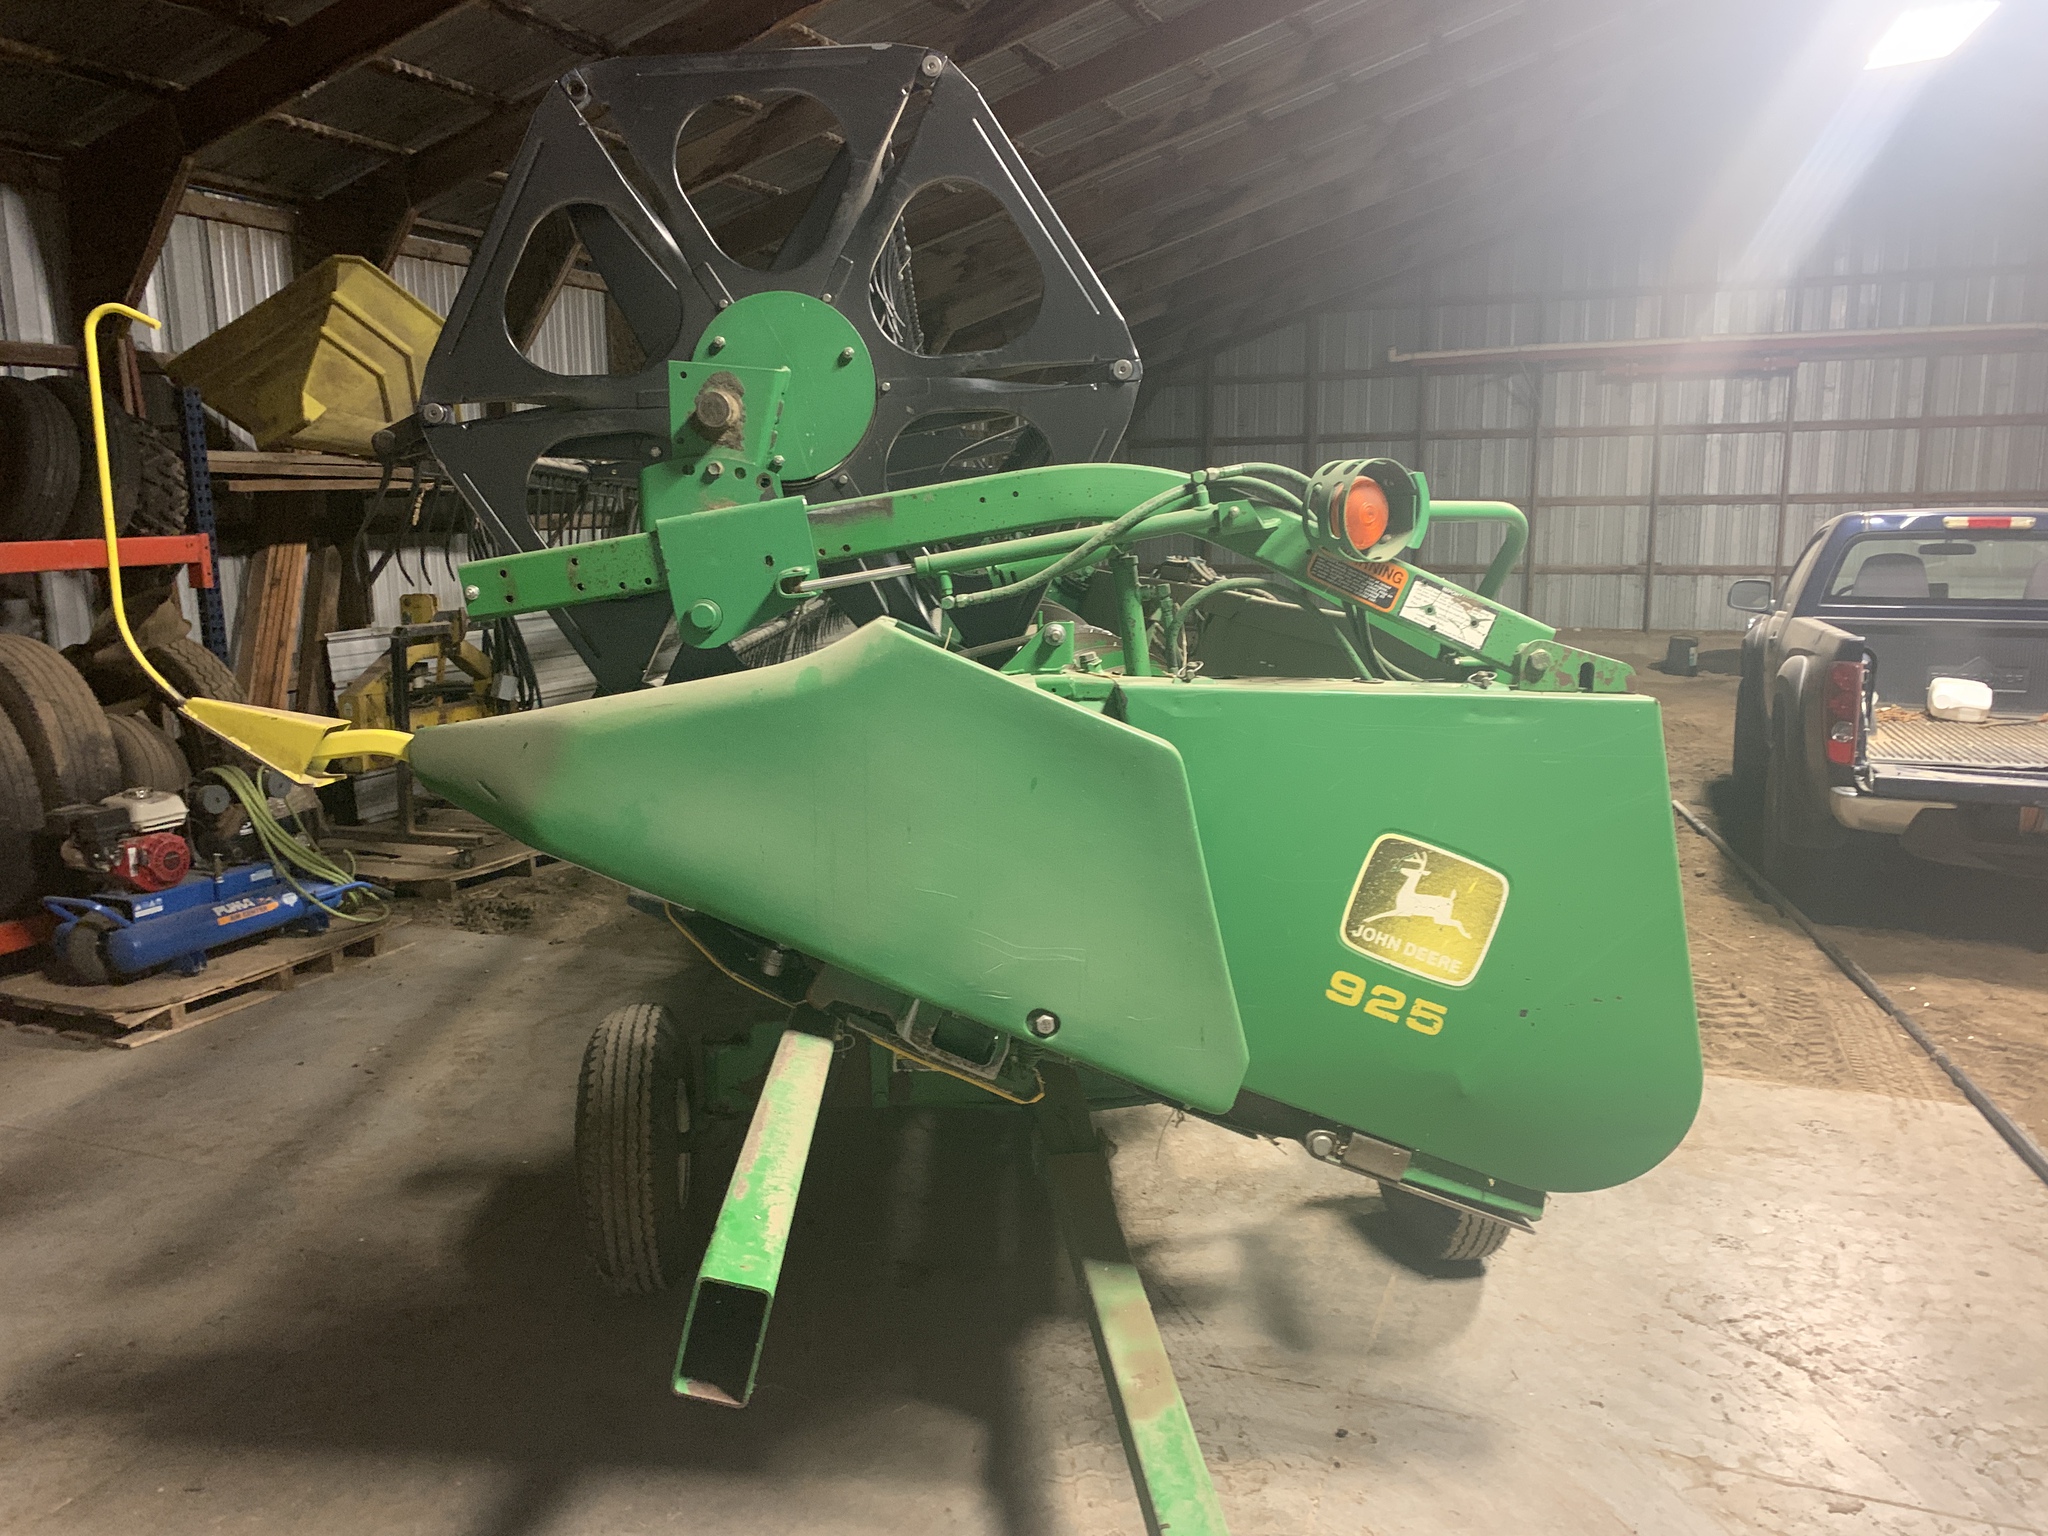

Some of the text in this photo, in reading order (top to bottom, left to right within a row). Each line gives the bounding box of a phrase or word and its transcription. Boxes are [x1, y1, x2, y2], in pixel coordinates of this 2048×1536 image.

[1355, 561, 1404, 584] RNING
[1352, 925, 1463, 974] JOHN DEERE
[1325, 970, 1448, 1036] 925
